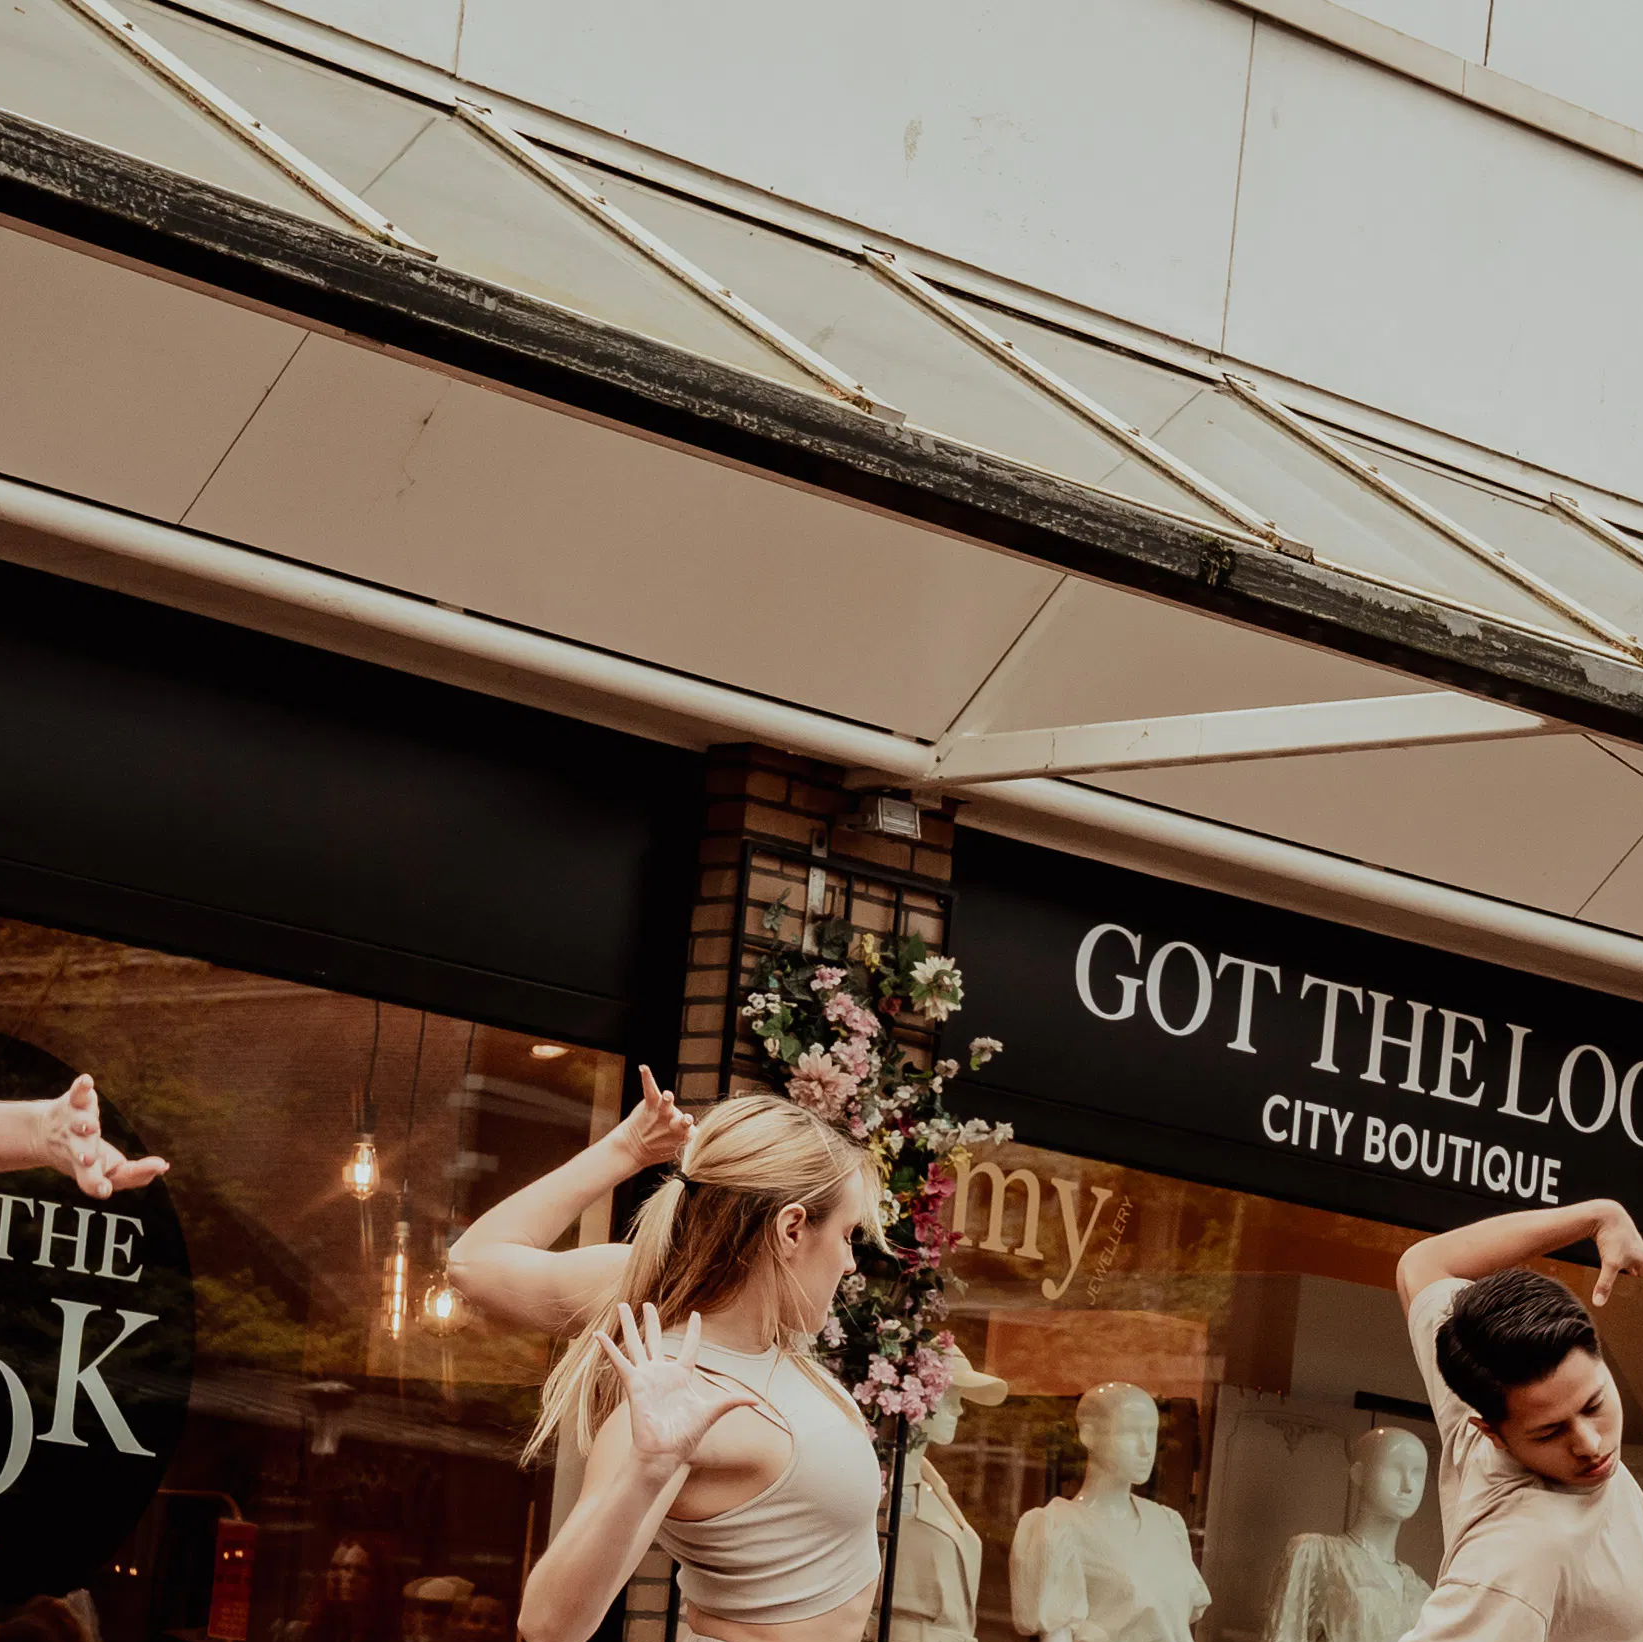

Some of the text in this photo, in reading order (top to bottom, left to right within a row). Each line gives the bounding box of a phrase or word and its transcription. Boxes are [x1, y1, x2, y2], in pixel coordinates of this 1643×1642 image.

[1075, 922, 1282, 1055] GOT
[1300, 972, 1487, 1108] THE
[1262, 1093, 1563, 1206] CITY BOUTIQUE
[953, 1160, 1115, 1301] my
[1084, 1195, 1135, 1306] JEWELLERY
